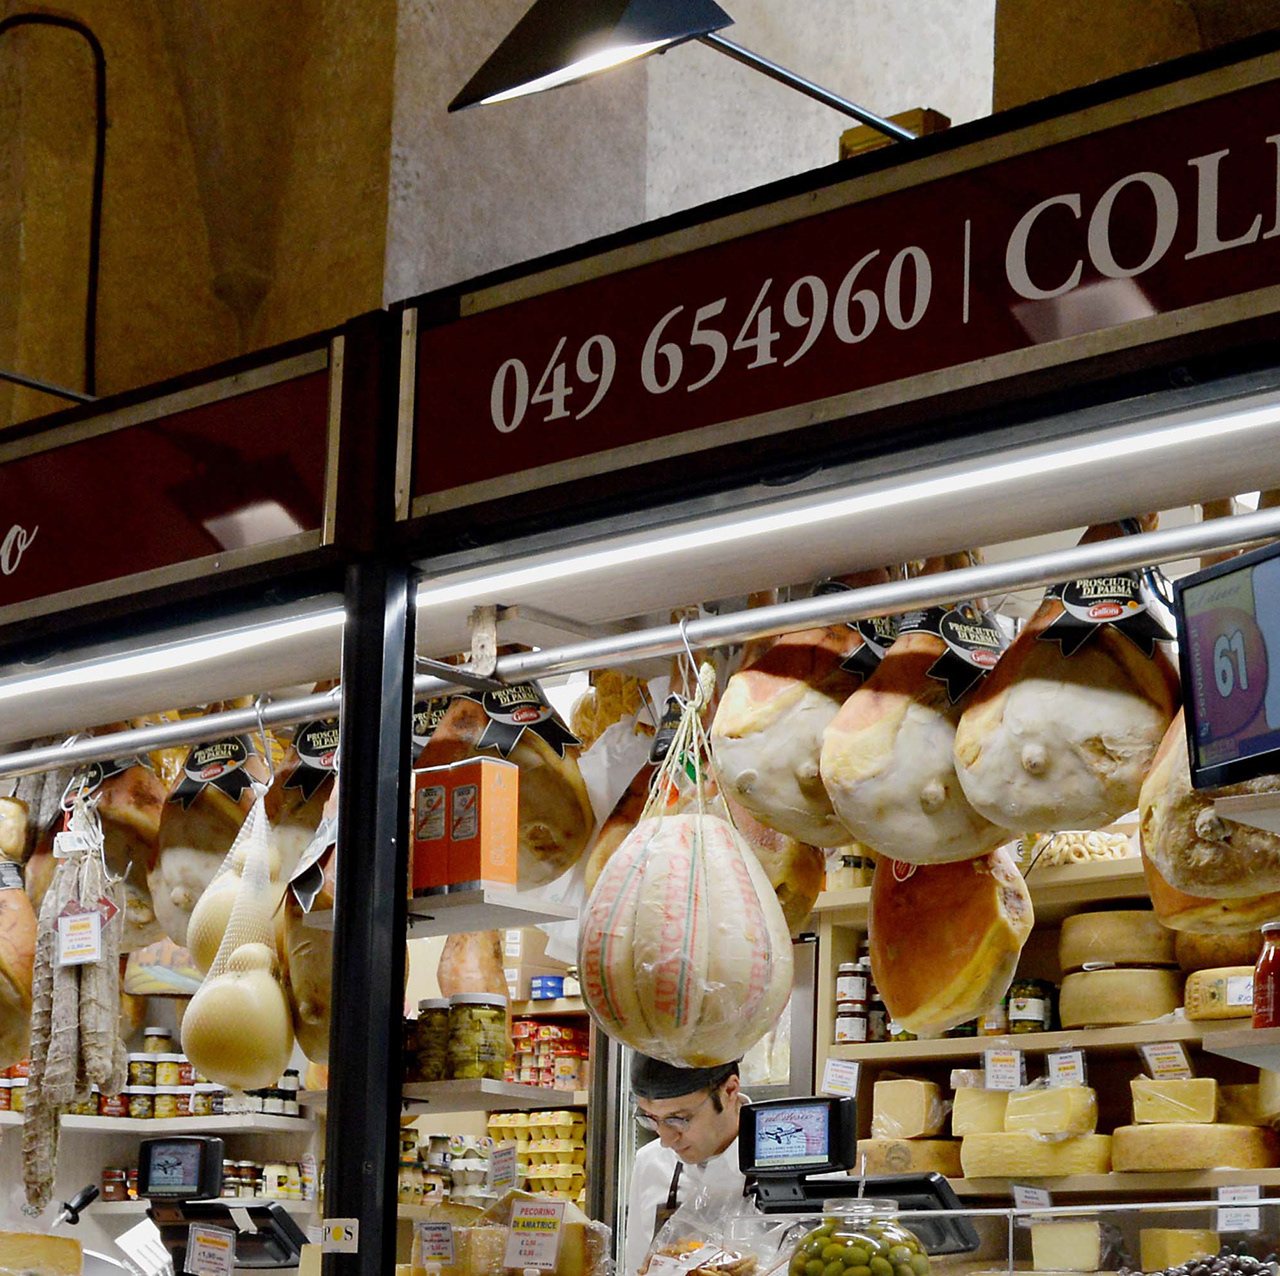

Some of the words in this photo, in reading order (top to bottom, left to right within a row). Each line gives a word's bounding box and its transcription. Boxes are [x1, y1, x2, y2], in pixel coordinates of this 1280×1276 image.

[490, 334, 617, 433] 049
[640, 246, 933, 393] 654960
[1076, 578, 1139, 590] PROSCIUTTO
[1097, 584, 1132, 596] PARMA
[1213, 630, 1248, 698] 61
[521, 1208, 555, 1216] PECORINO
[522, 1221, 556, 1229] AMATRICE
